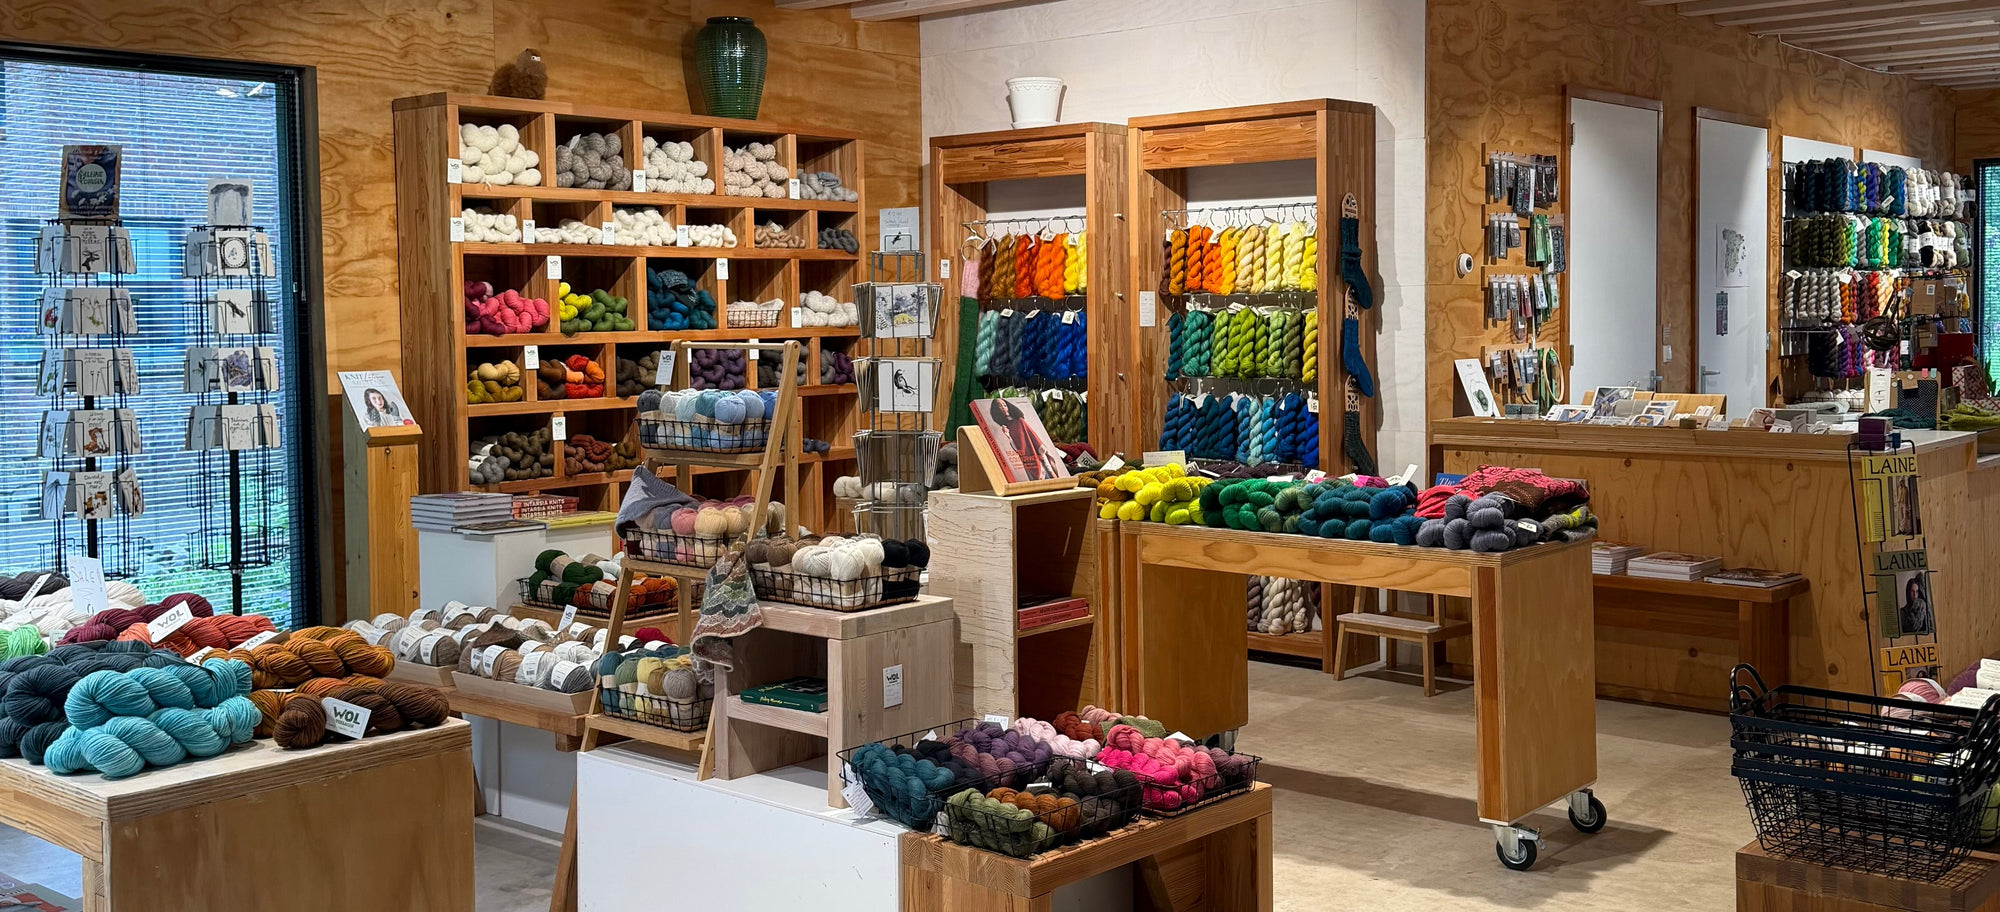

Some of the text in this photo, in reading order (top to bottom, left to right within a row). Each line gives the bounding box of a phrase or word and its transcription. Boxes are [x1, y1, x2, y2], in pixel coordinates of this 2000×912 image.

[1869, 457, 1917, 474] LAINE
[1877, 551, 1927, 571] LAINE
[157, 609, 184, 628] WOL
[1886, 646, 1937, 667] LAINE
[886, 672, 900, 681] WOL
[333, 706, 361, 725] WOL
